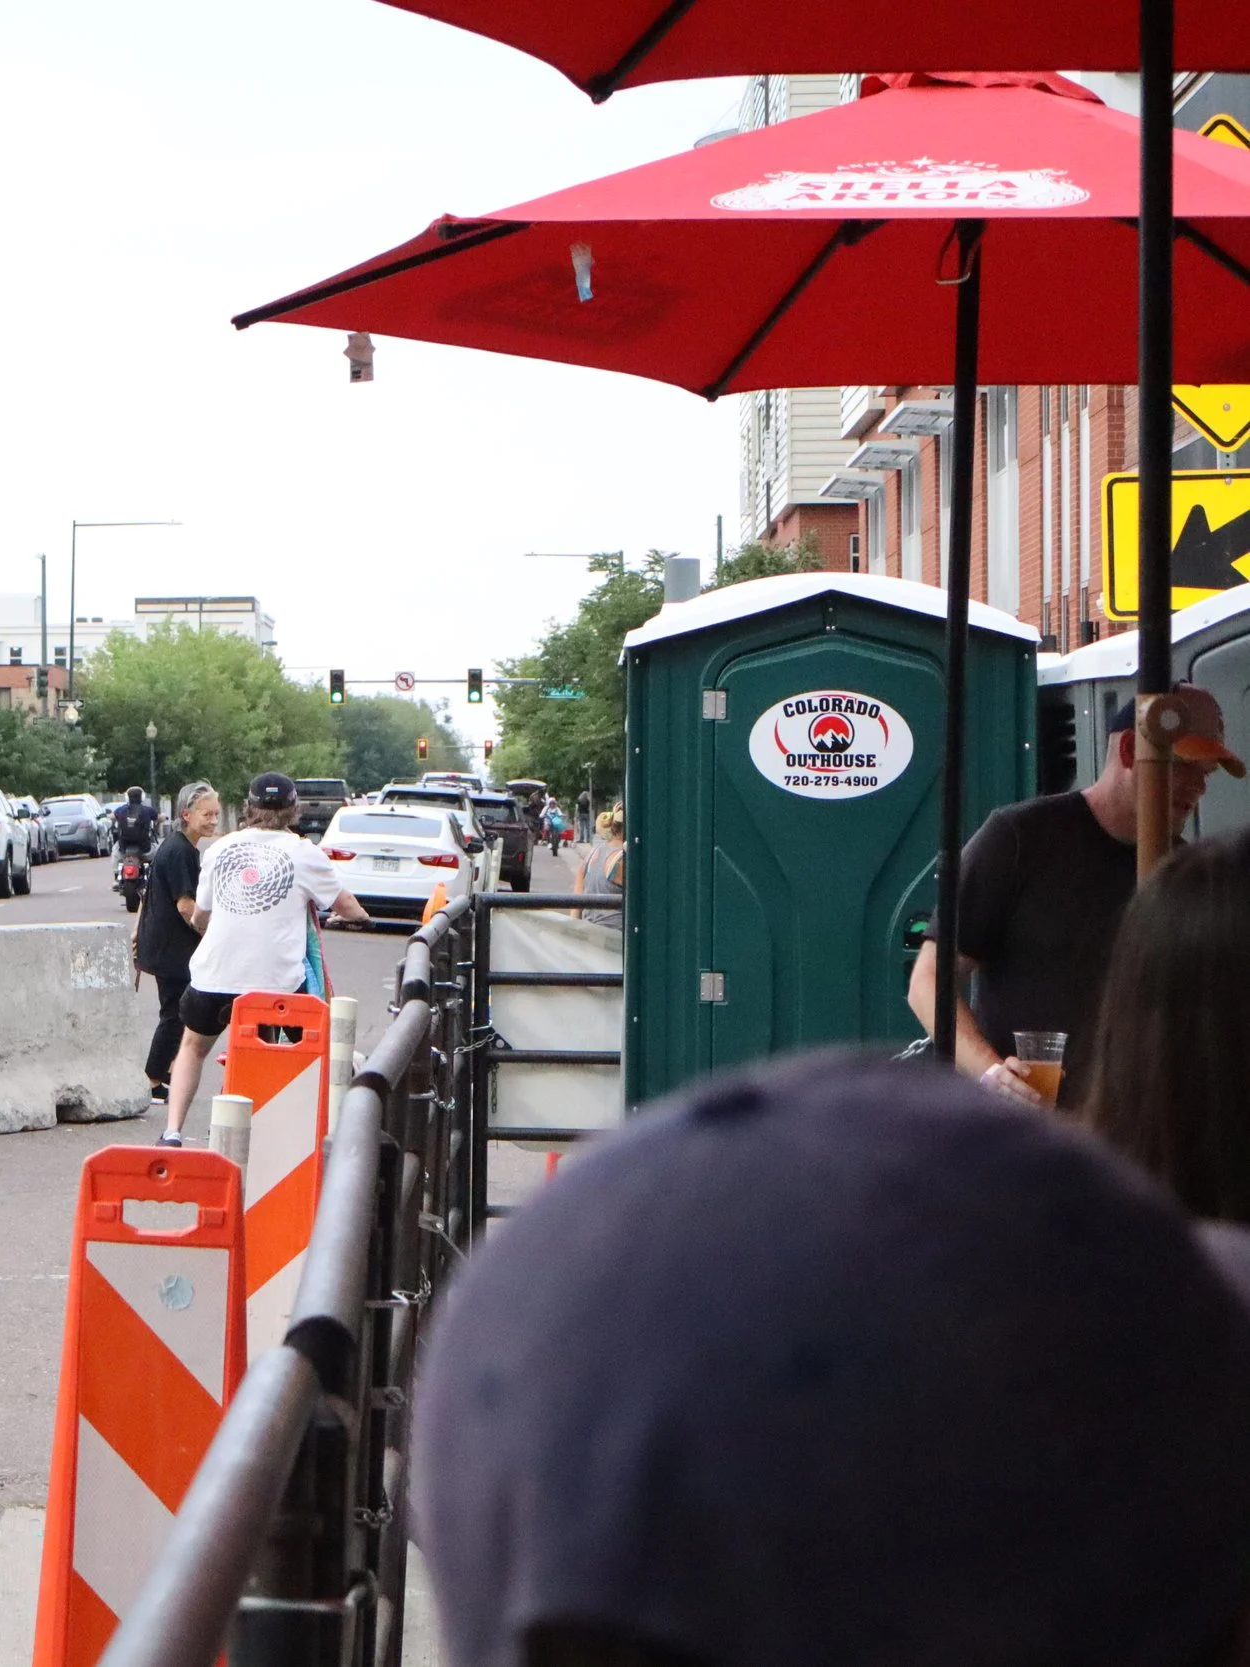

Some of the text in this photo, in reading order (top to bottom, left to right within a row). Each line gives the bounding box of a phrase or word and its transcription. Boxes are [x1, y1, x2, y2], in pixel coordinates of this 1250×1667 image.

[800, 180, 1019, 191] STELLA
[782, 191, 1018, 202] ARTOIS
[783, 697, 881, 719] COLORADO
[786, 753, 877, 767] OUTHOUSE
[784, 775, 878, 786] 720-279-4900
